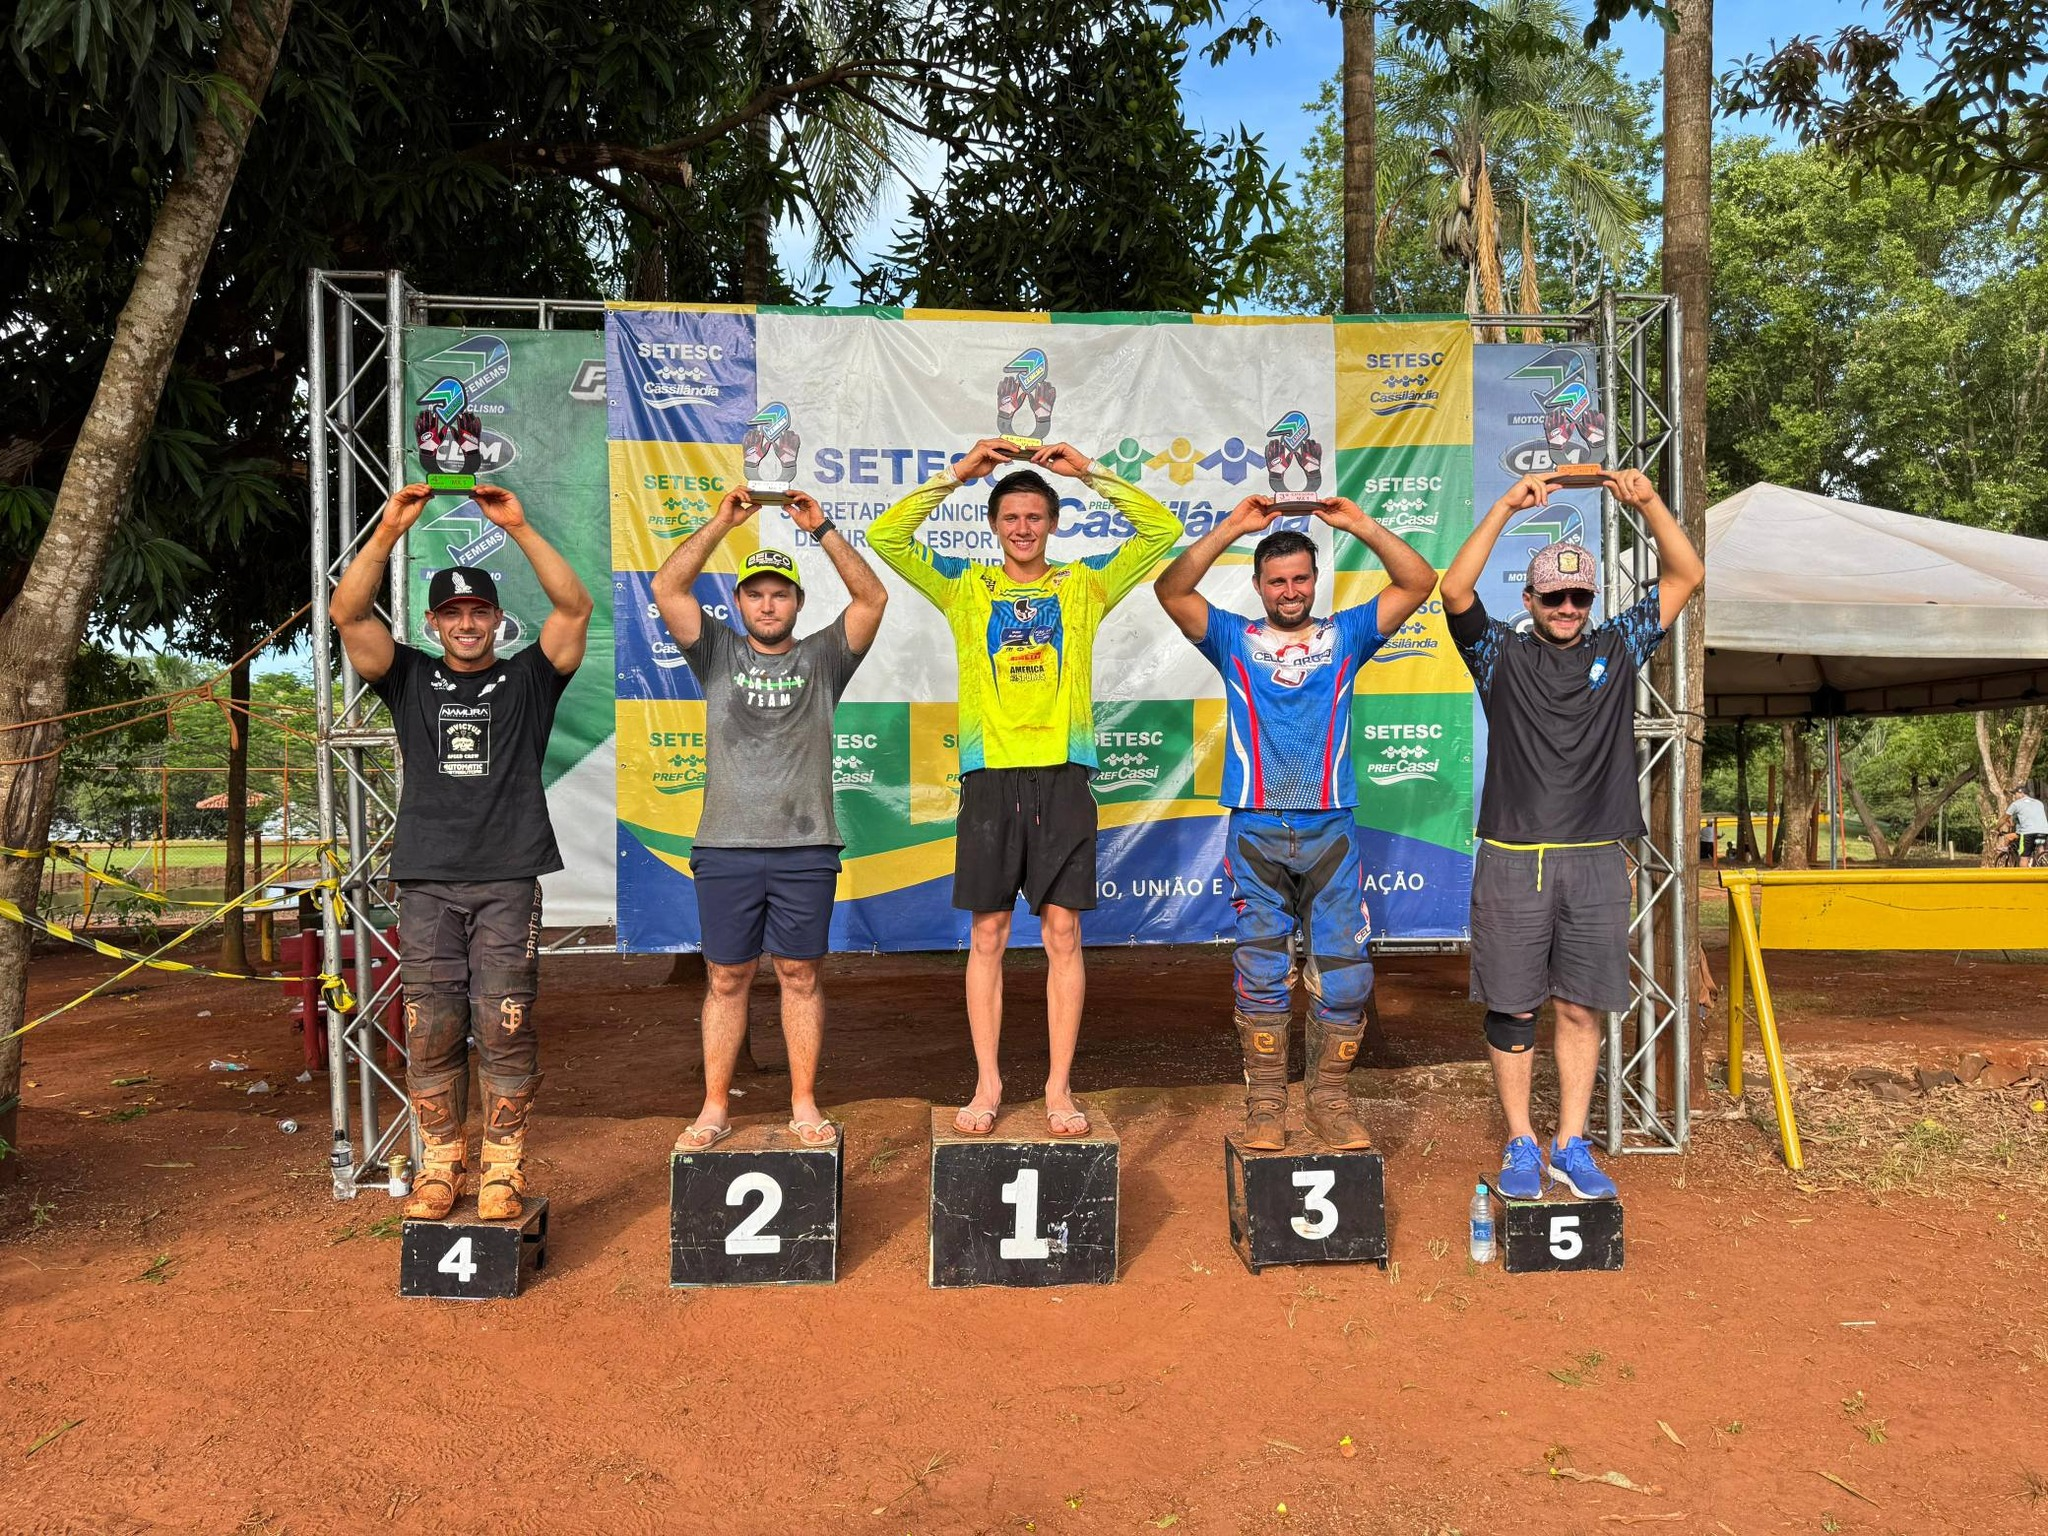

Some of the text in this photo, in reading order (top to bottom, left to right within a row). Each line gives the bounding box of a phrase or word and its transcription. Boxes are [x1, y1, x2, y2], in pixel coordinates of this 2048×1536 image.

[638, 342, 723, 361] SETESC
[1366, 351, 1444, 369] SETESC
[643, 381, 720, 397] Cassilândia
[1370, 389, 1440, 403] Cassilândia
[644, 475, 725, 491] SETESC
[1365, 476, 1442, 493] SETESC
[458, 532, 504, 566] FEMEMS
[1010, 665, 1045, 674] AMERICA
[747, 691, 791, 708] TEAM
[441, 707, 489, 716] NAMURA
[446, 723, 482, 736] INVICTUS
[1364, 724, 1443, 740] SETESC
[649, 732, 706, 747] SETE
[833, 734, 878, 749] ESC
[1097, 765, 1159, 780] REFCassi
[1132, 876, 1203, 897] UNIÃO
[1212, 878, 1223, 895] E
[725, 1172, 783, 1255] 2
[1000, 1168, 1049, 1260] 1
[1290, 1170, 1339, 1241] 3
[1549, 1216, 1583, 1260] 5
[437, 1236, 478, 1282] 4
